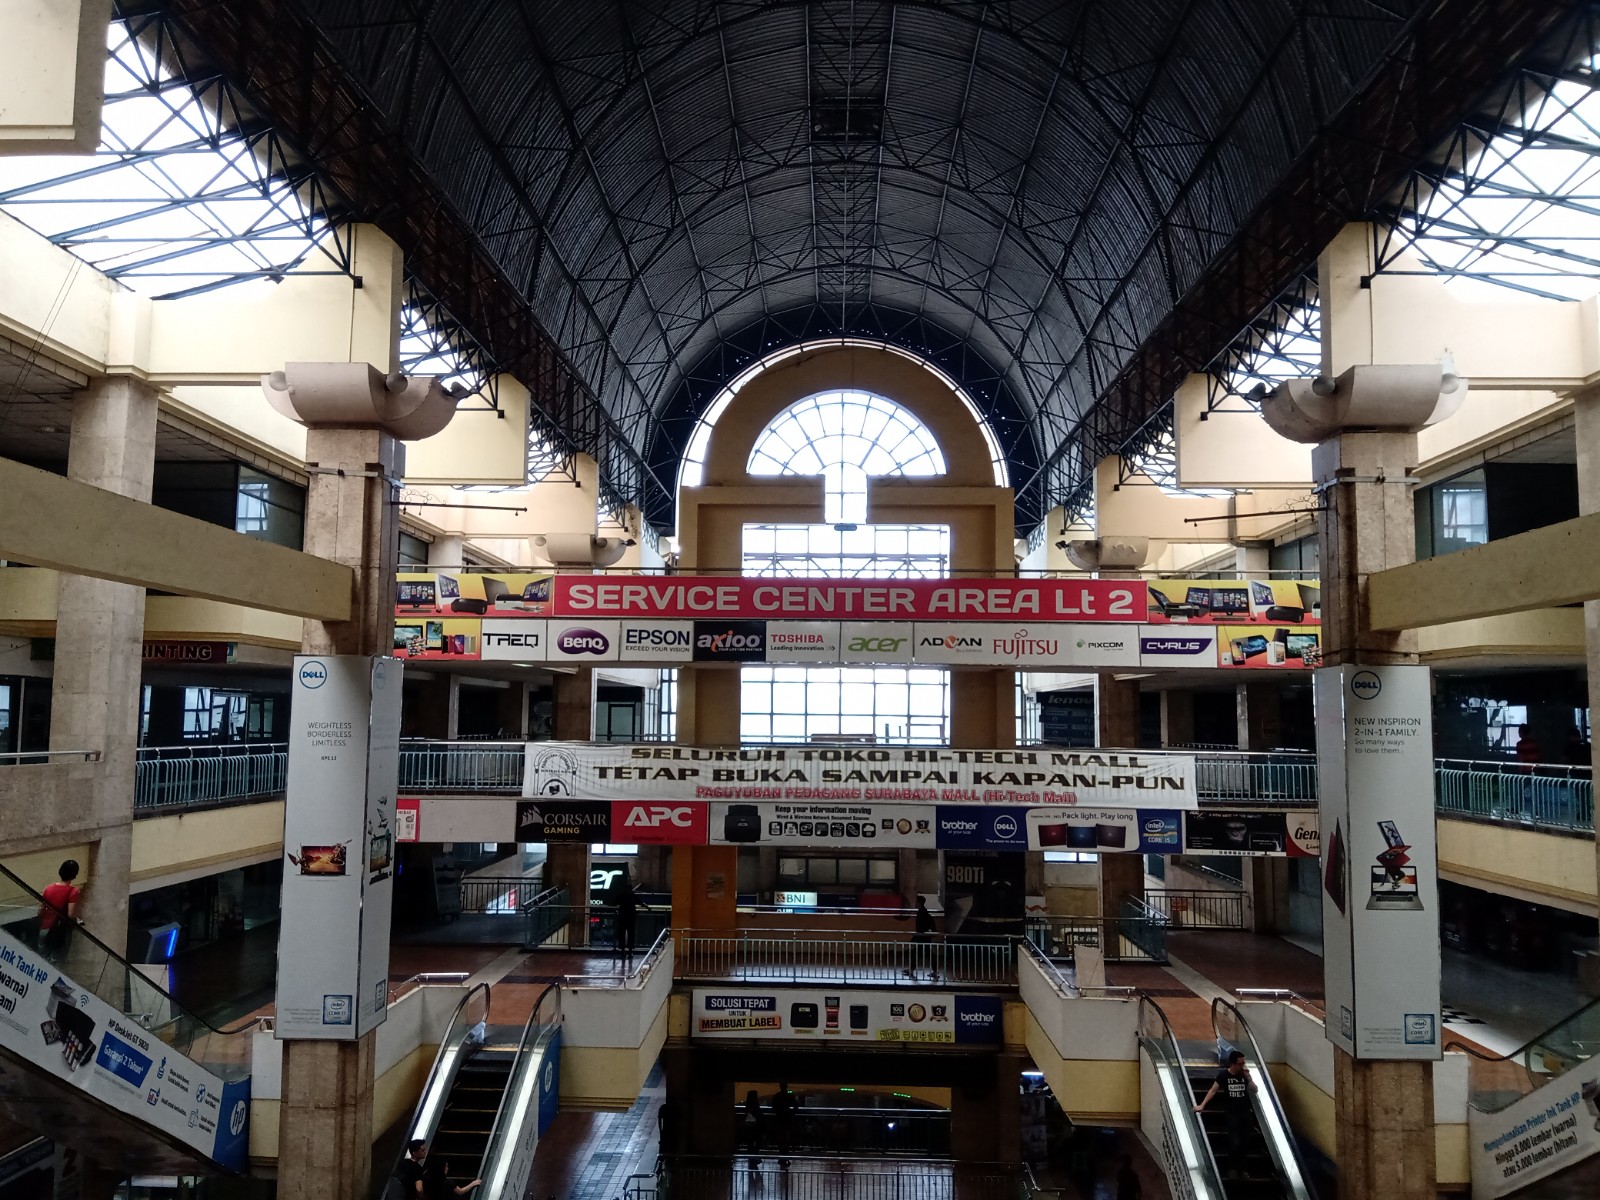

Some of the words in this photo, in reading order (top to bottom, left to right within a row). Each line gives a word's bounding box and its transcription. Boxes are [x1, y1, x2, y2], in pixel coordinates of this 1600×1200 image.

[568, 584, 741, 611] SERVICE
[752, 586, 916, 613] CENTER
[927, 588, 1039, 614] AREA
[1055, 589, 1096, 615] Lt
[1108, 590, 1133, 615] 2
[626, 629, 690, 646] EPSON
[697, 630, 761, 653] axioo
[771, 634, 824, 643] TOSHIBA
[920, 635, 983, 650] ADVAN
[848, 637, 908, 653] acer
[993, 635, 1058, 660] FUJITSU
[1146, 641, 1201, 650] CYRUS
[302, 671, 324, 679] DELL
[1354, 681, 1379, 689] DELL
[1377, 718, 1421, 726] INSPIRON
[1354, 728, 1383, 736] 2-IN-1
[630, 747, 785, 762] SELURUH
[797, 750, 890, 762] TOKO
[904, 750, 1037, 765] HI-TECH
[1052, 753, 1148, 768] MALL
[593, 766, 700, 781] TETAP
[712, 769, 809, 783] BUKA
[822, 769, 959, 784] SAMPAI
[973, 771, 1185, 791] KAPAN-PUN
[696, 786, 781, 799] PAGUYUBAN
[784, 787, 861, 800] PEDAGANG
[864, 788, 938, 801] SURABAYA
[942, 789, 980, 801] MALL
[983, 790, 1040, 804] (Hi-Tech
[1043, 791, 1077, 805] Mall)
[623, 806, 692, 827] APC
[809, 806, 847, 814] information
[848, 807, 872, 815] moving
[1080, 812, 1099, 820] light.
[1100, 813, 1115, 821] Play
[1116, 813, 1134, 821] long
[544, 813, 608, 826] CORSAIR
[941, 820, 977, 830] brother
[1148, 836, 1162, 844] CORE
[946, 865, 985, 884] 980Ti
[786, 894, 806, 904] BNI
[1, 945, 17, 966] Ink
[16, 955, 36, 978] Tank
[35, 968, 48, 985] HP
[711, 998, 742, 1008] SOLUSI
[743, 998, 770, 1009] TEPAT
[936, 1007, 942, 1015] 3
[960, 1012, 995, 1022] brother
[107, 1018, 115, 1029] HP
[701, 1019, 746, 1029] MEMBUAT
[749, 1018, 778, 1028] LABEL
[122, 1055, 129, 1065] 2
[231, 1101, 246, 1135] hp
[1526, 1113, 1547, 1130] Printer
[1545, 1106, 1558, 1119] Ink
[1555, 1098, 1572, 1113] Tank
[1495, 1150, 1515, 1166] Hingga
[1514, 1137, 1532, 1155] 8.000
[1529, 1128, 1553, 1147] lembar
[1551, 1112, 1578, 1137] (warna)
[1502, 1166, 1517, 1179] atau
[1515, 1155, 1533, 1173] 5.000
[1531, 1146, 1554, 1164] lembar
[1552, 1131, 1578, 1154] (hitam)
